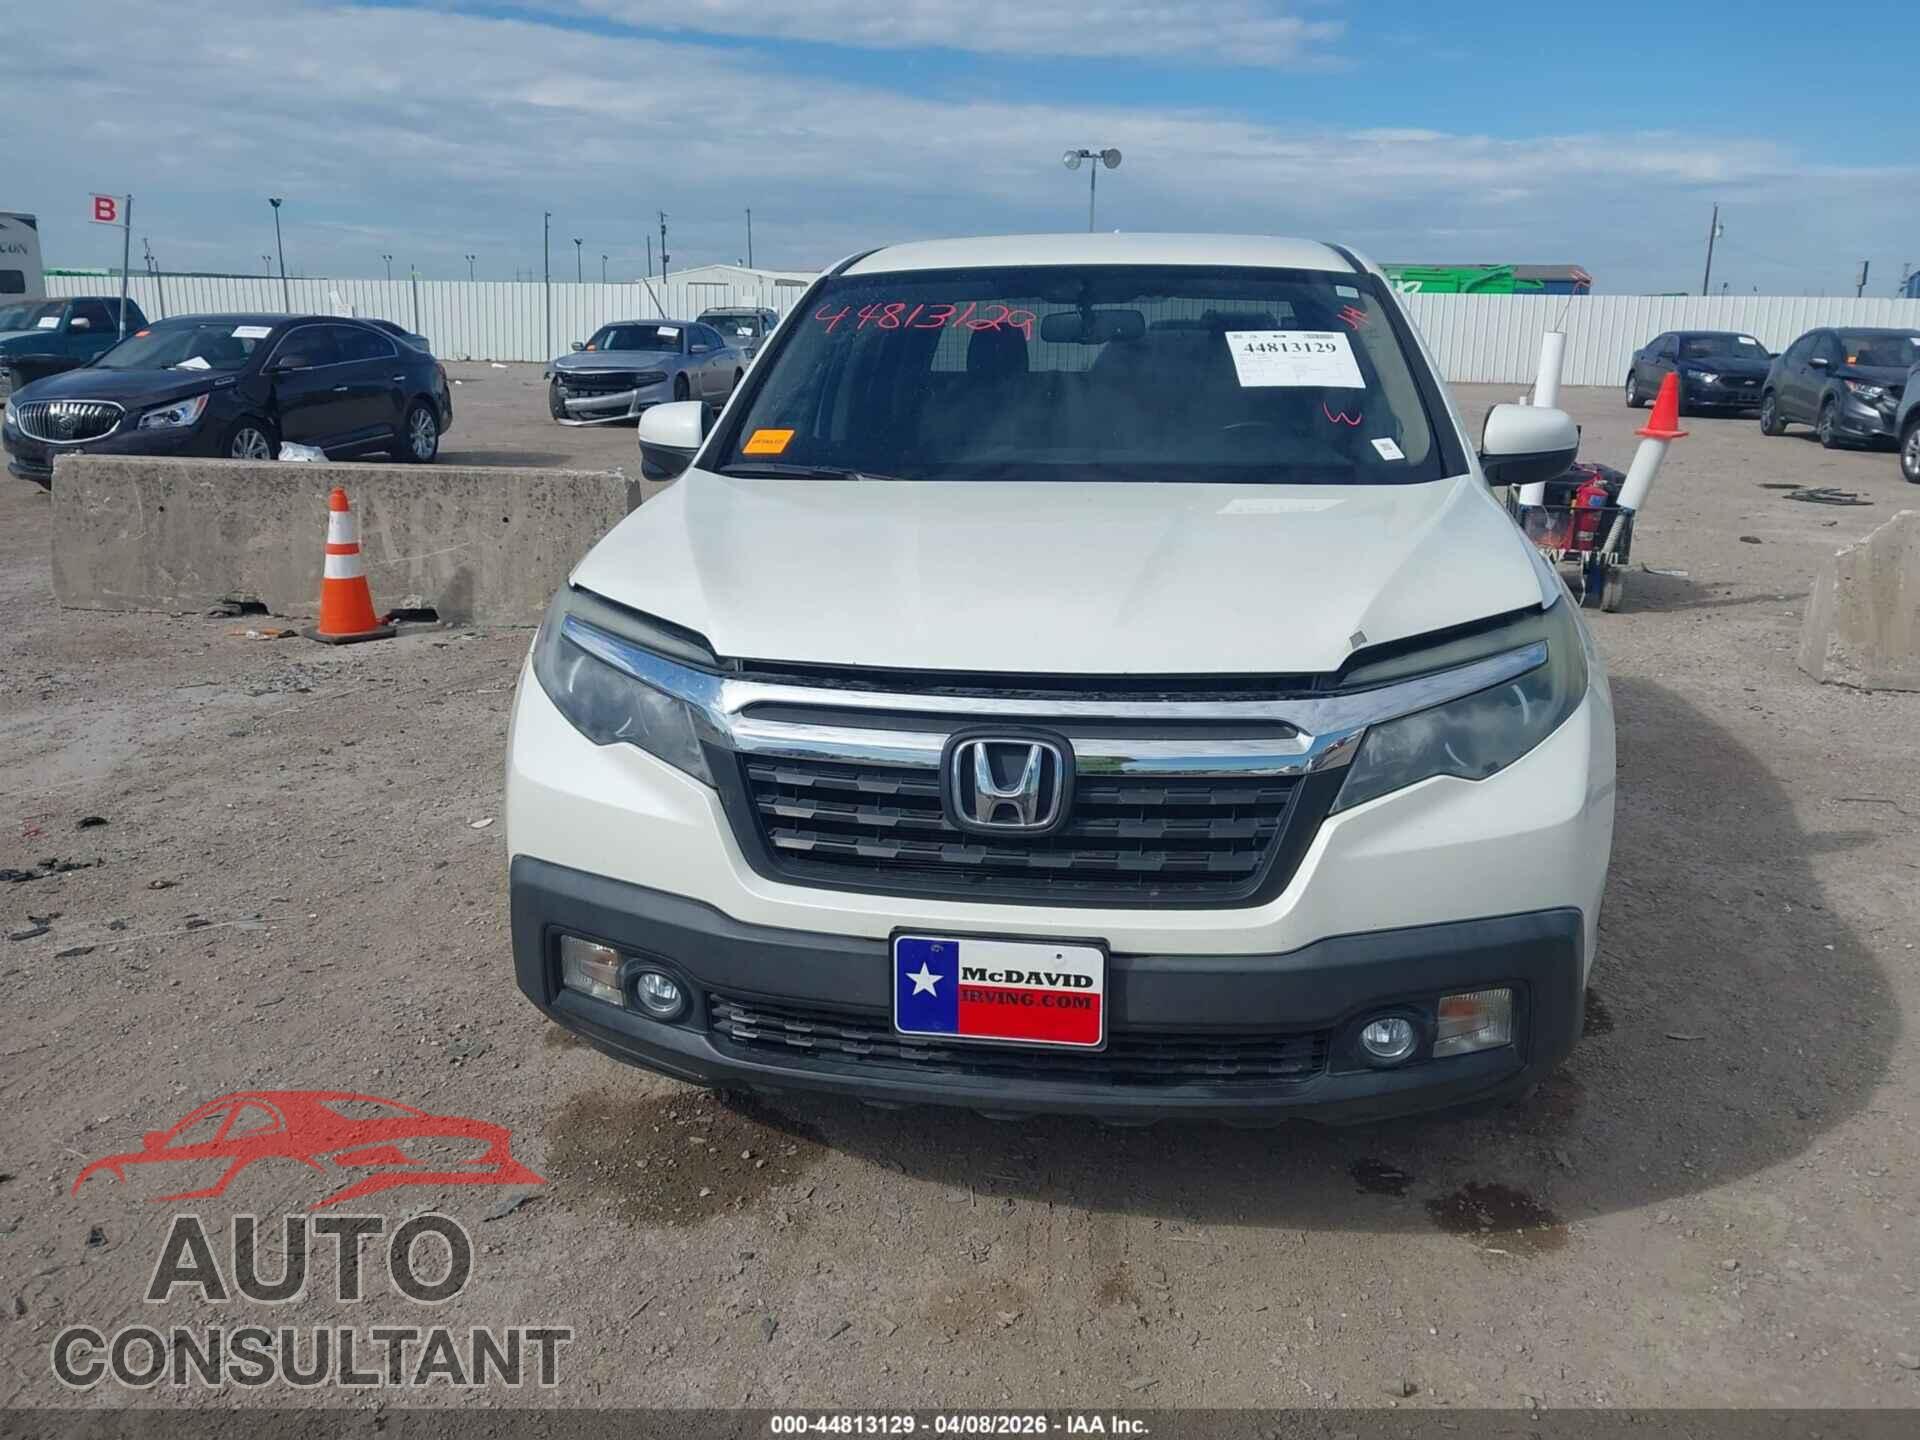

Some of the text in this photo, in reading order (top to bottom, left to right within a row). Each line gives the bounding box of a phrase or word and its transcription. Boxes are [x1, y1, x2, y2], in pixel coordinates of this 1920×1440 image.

[95, 197, 116, 221] B
[815, 302, 1037, 341] 44813129
[1244, 342, 1337, 353] 44813129
[962, 967, 1094, 989] McDAVID
[960, 989, 1093, 1010] IRVING.COM
